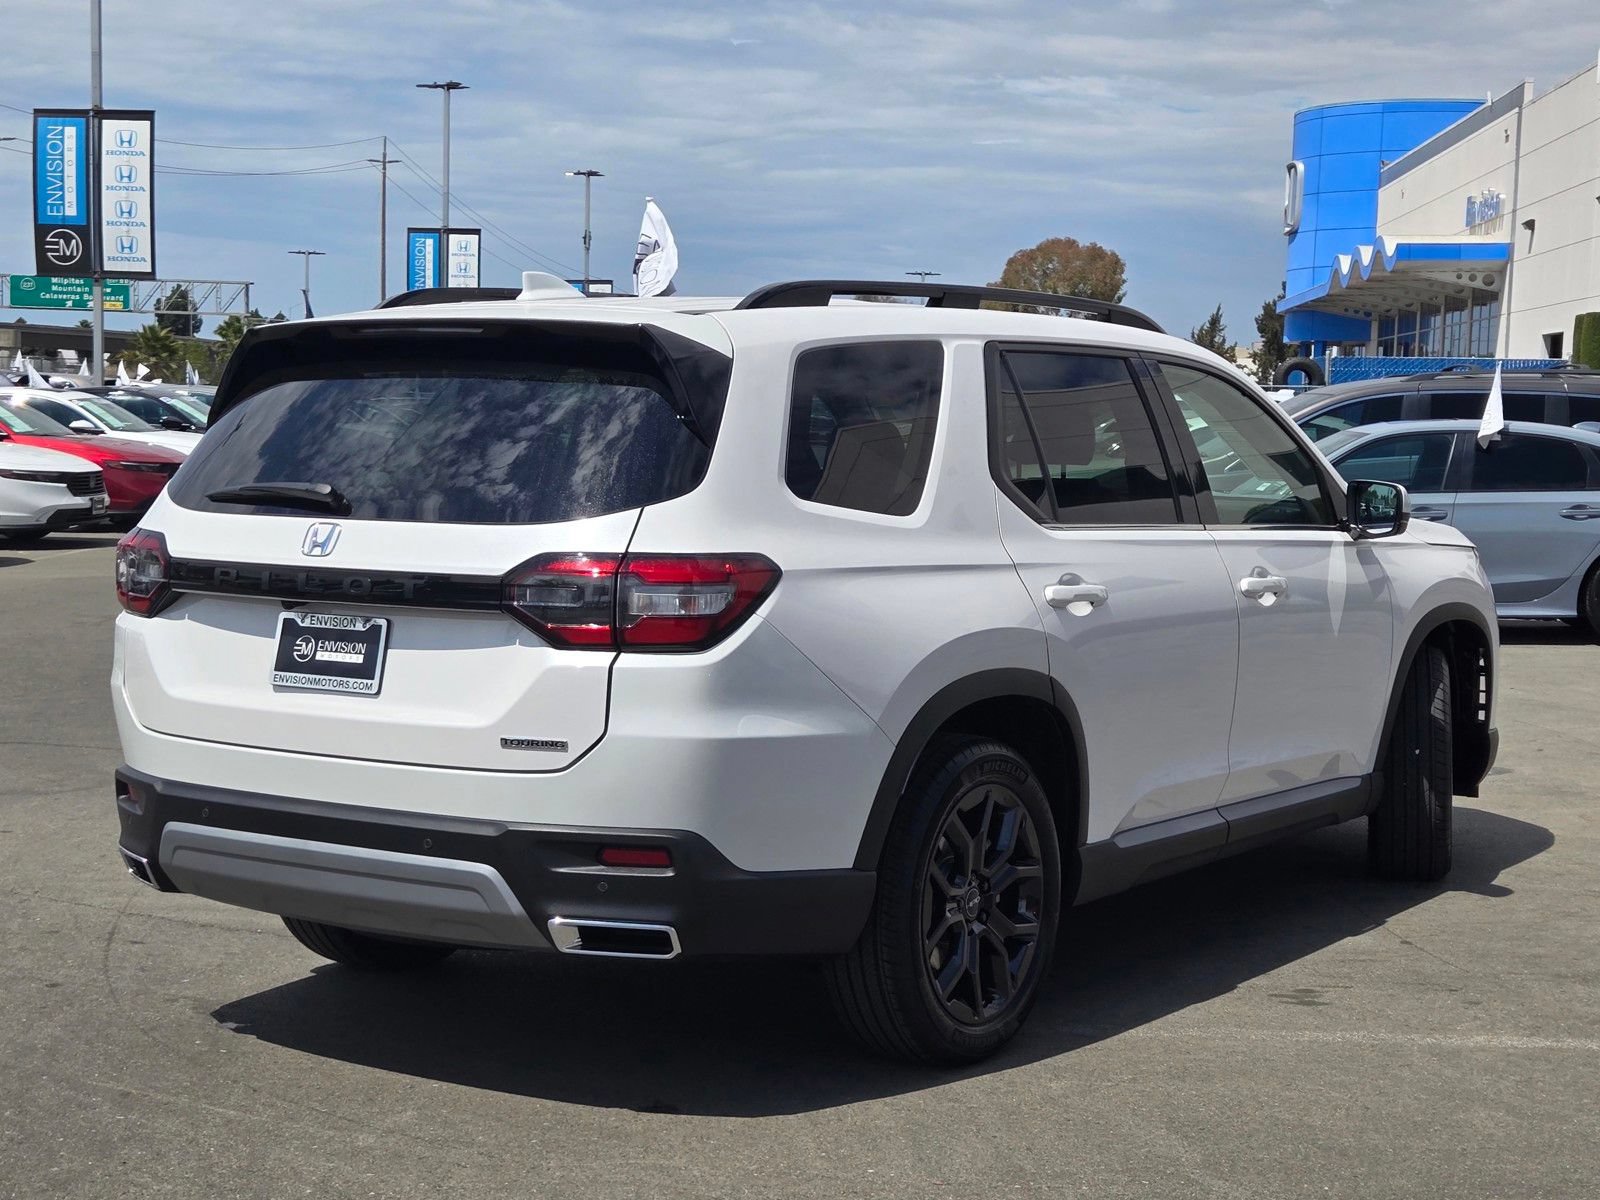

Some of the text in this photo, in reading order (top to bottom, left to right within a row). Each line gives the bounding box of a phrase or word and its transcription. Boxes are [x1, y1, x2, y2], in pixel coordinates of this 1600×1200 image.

[46, 126, 64, 216] ENVISION
[40, 292, 80, 300] Calaveras
[213, 567, 428, 598] PILOT
[309, 615, 357, 628] ENVISION
[317, 640, 367, 654] ENVISION
[273, 673, 373, 691] ENVISIONMOTORS.COM
[501, 738, 566, 747] TOURING
